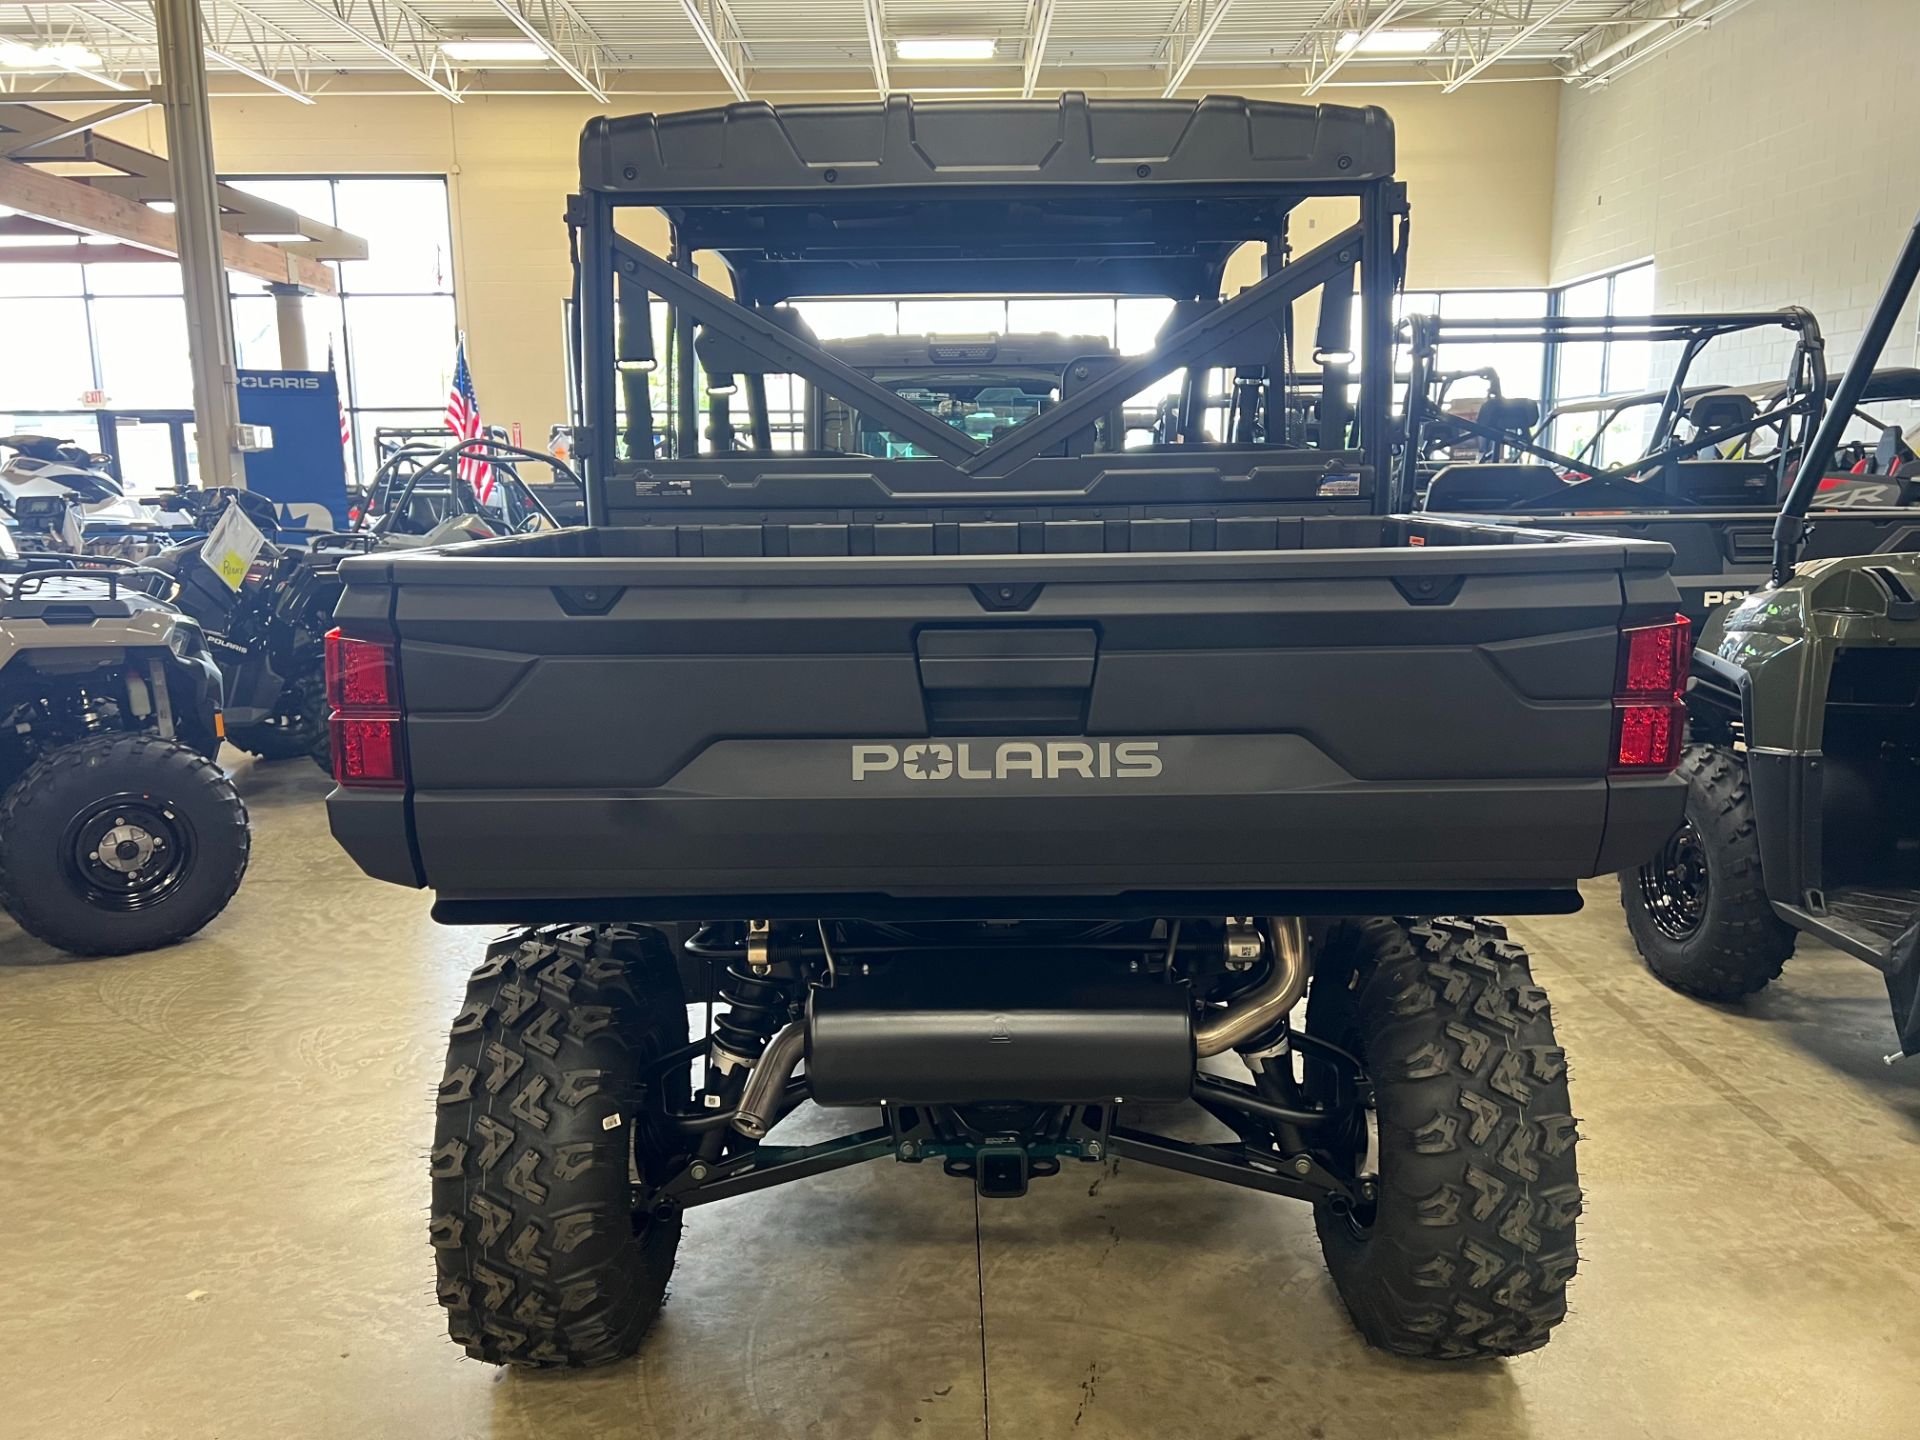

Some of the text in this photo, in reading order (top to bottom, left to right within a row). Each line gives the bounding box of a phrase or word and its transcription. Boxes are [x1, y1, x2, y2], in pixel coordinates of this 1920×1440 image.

[85, 391, 102, 403] EXIT
[208, 636, 248, 654] POLARIS
[852, 742, 1163, 781] POLARIS
